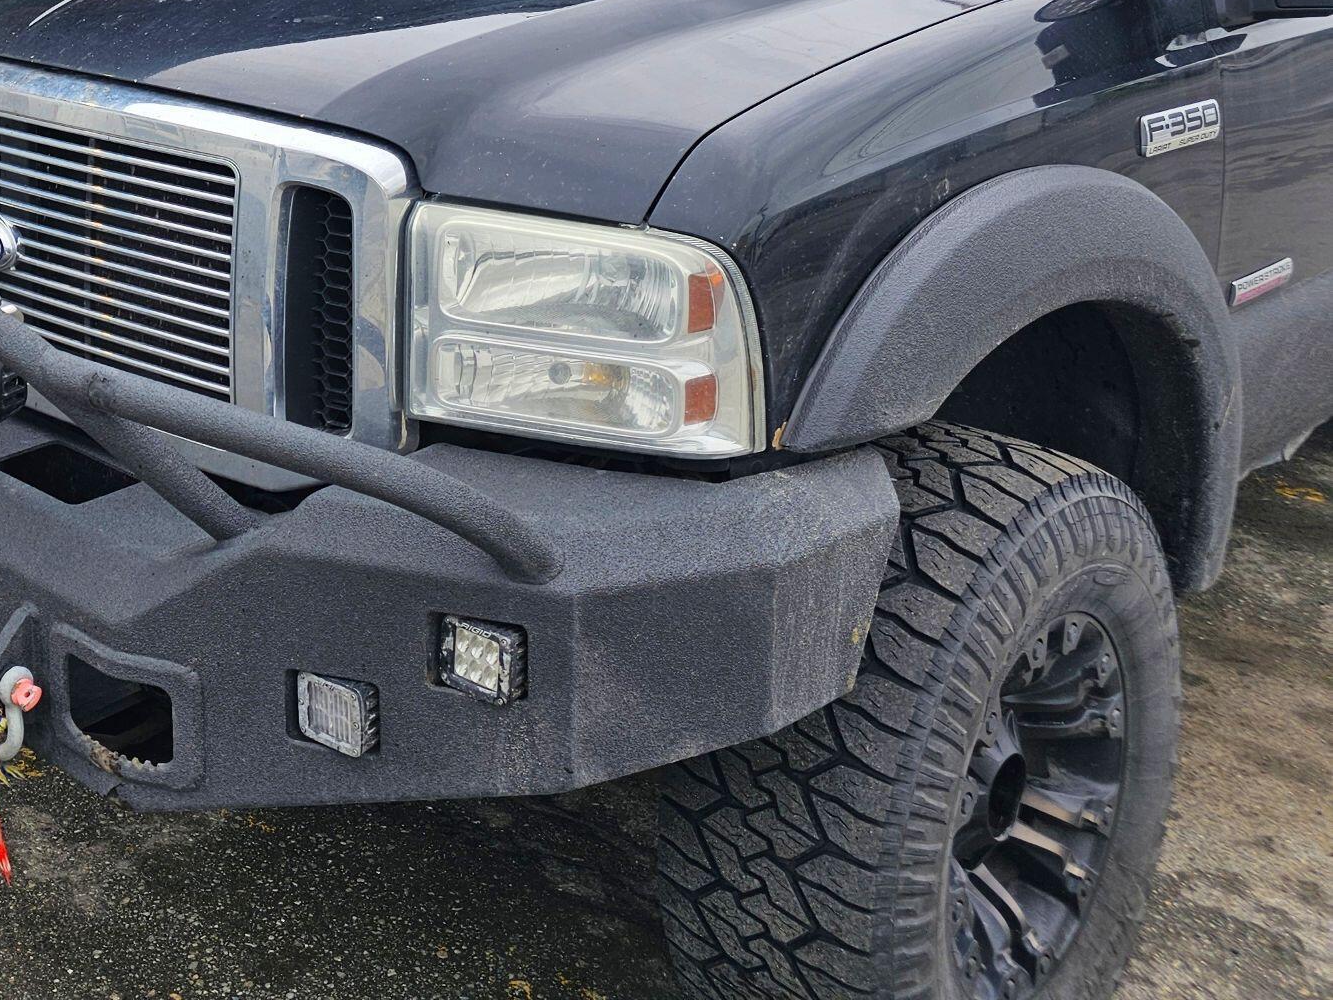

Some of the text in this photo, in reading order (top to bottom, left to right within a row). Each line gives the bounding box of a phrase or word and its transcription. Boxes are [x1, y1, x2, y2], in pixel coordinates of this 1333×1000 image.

[1148, 130, 1217, 155] LARIAT SUPER DUTY
[458, 622, 492, 639] RIGID
